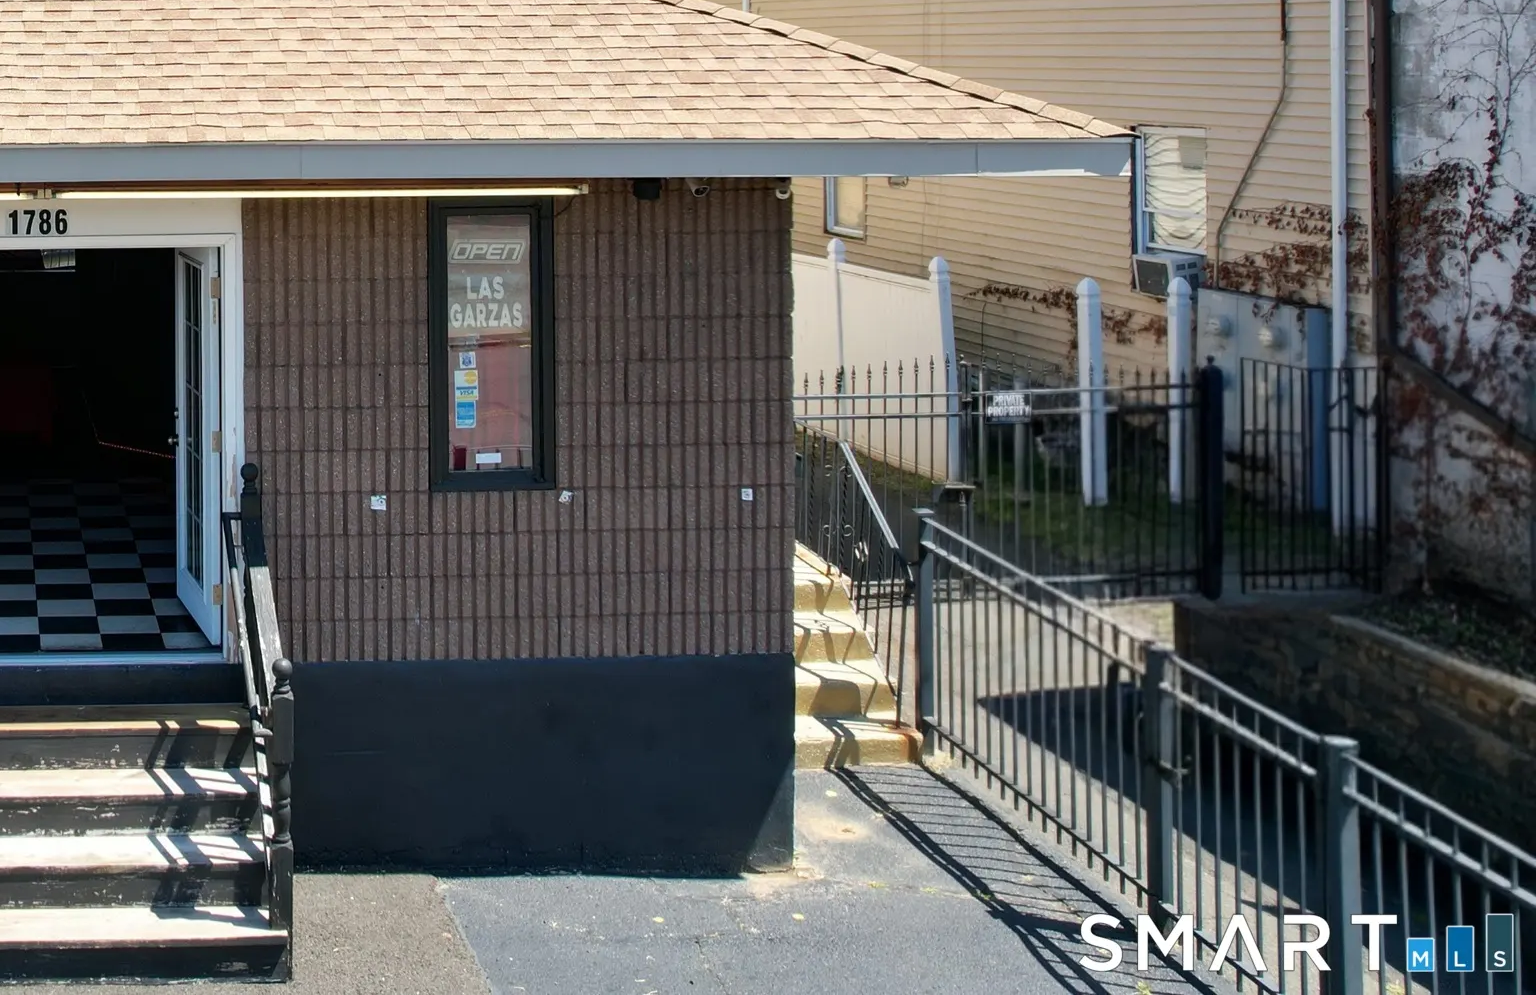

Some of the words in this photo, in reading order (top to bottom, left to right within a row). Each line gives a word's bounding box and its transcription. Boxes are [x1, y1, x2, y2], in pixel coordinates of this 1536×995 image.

[8, 209, 68, 235] 1786
[452, 243, 521, 260] OPEN
[466, 276, 505, 300] LAS
[449, 301, 524, 328] GARZAS
[992, 395, 1025, 406] PRIVATE
[987, 406, 1029, 417] PROPERTY
